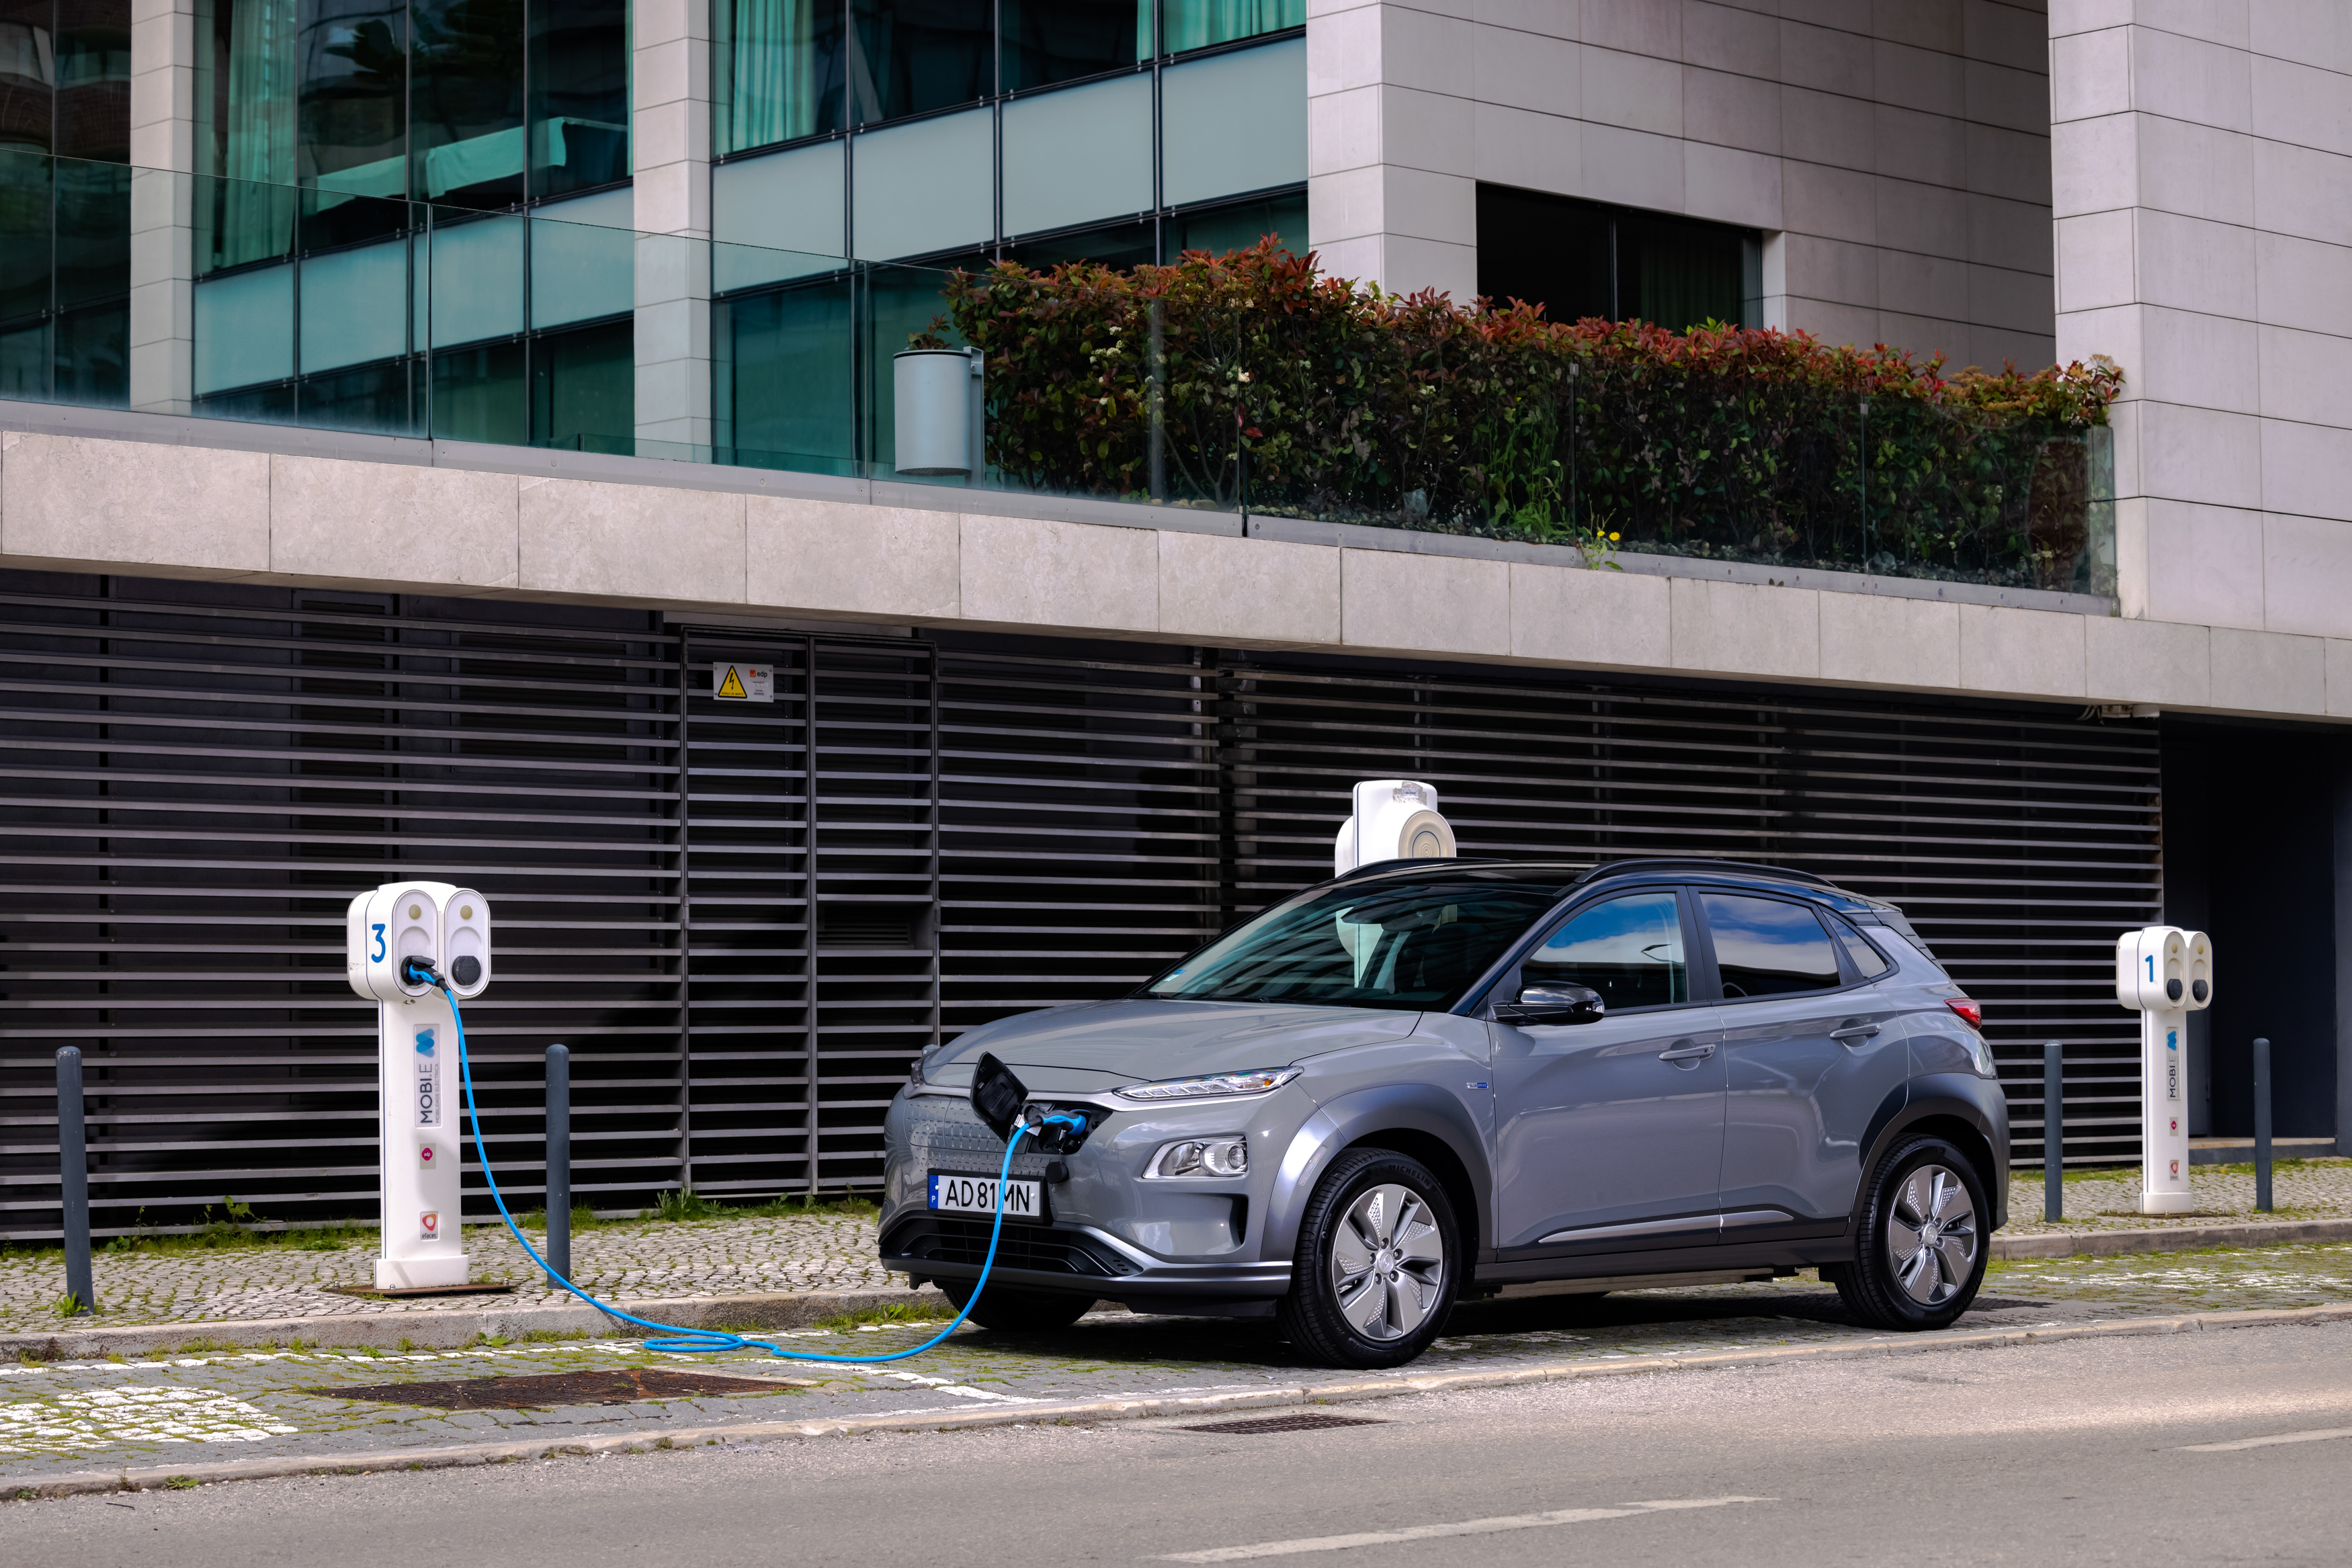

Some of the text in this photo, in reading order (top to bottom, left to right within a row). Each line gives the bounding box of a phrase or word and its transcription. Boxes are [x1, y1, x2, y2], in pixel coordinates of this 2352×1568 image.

[757, 670, 767, 679] edp
[371, 924, 386, 963] 3
[2145, 955, 2153, 982] 1
[1388, 1165, 1431, 1186] MICHELIN
